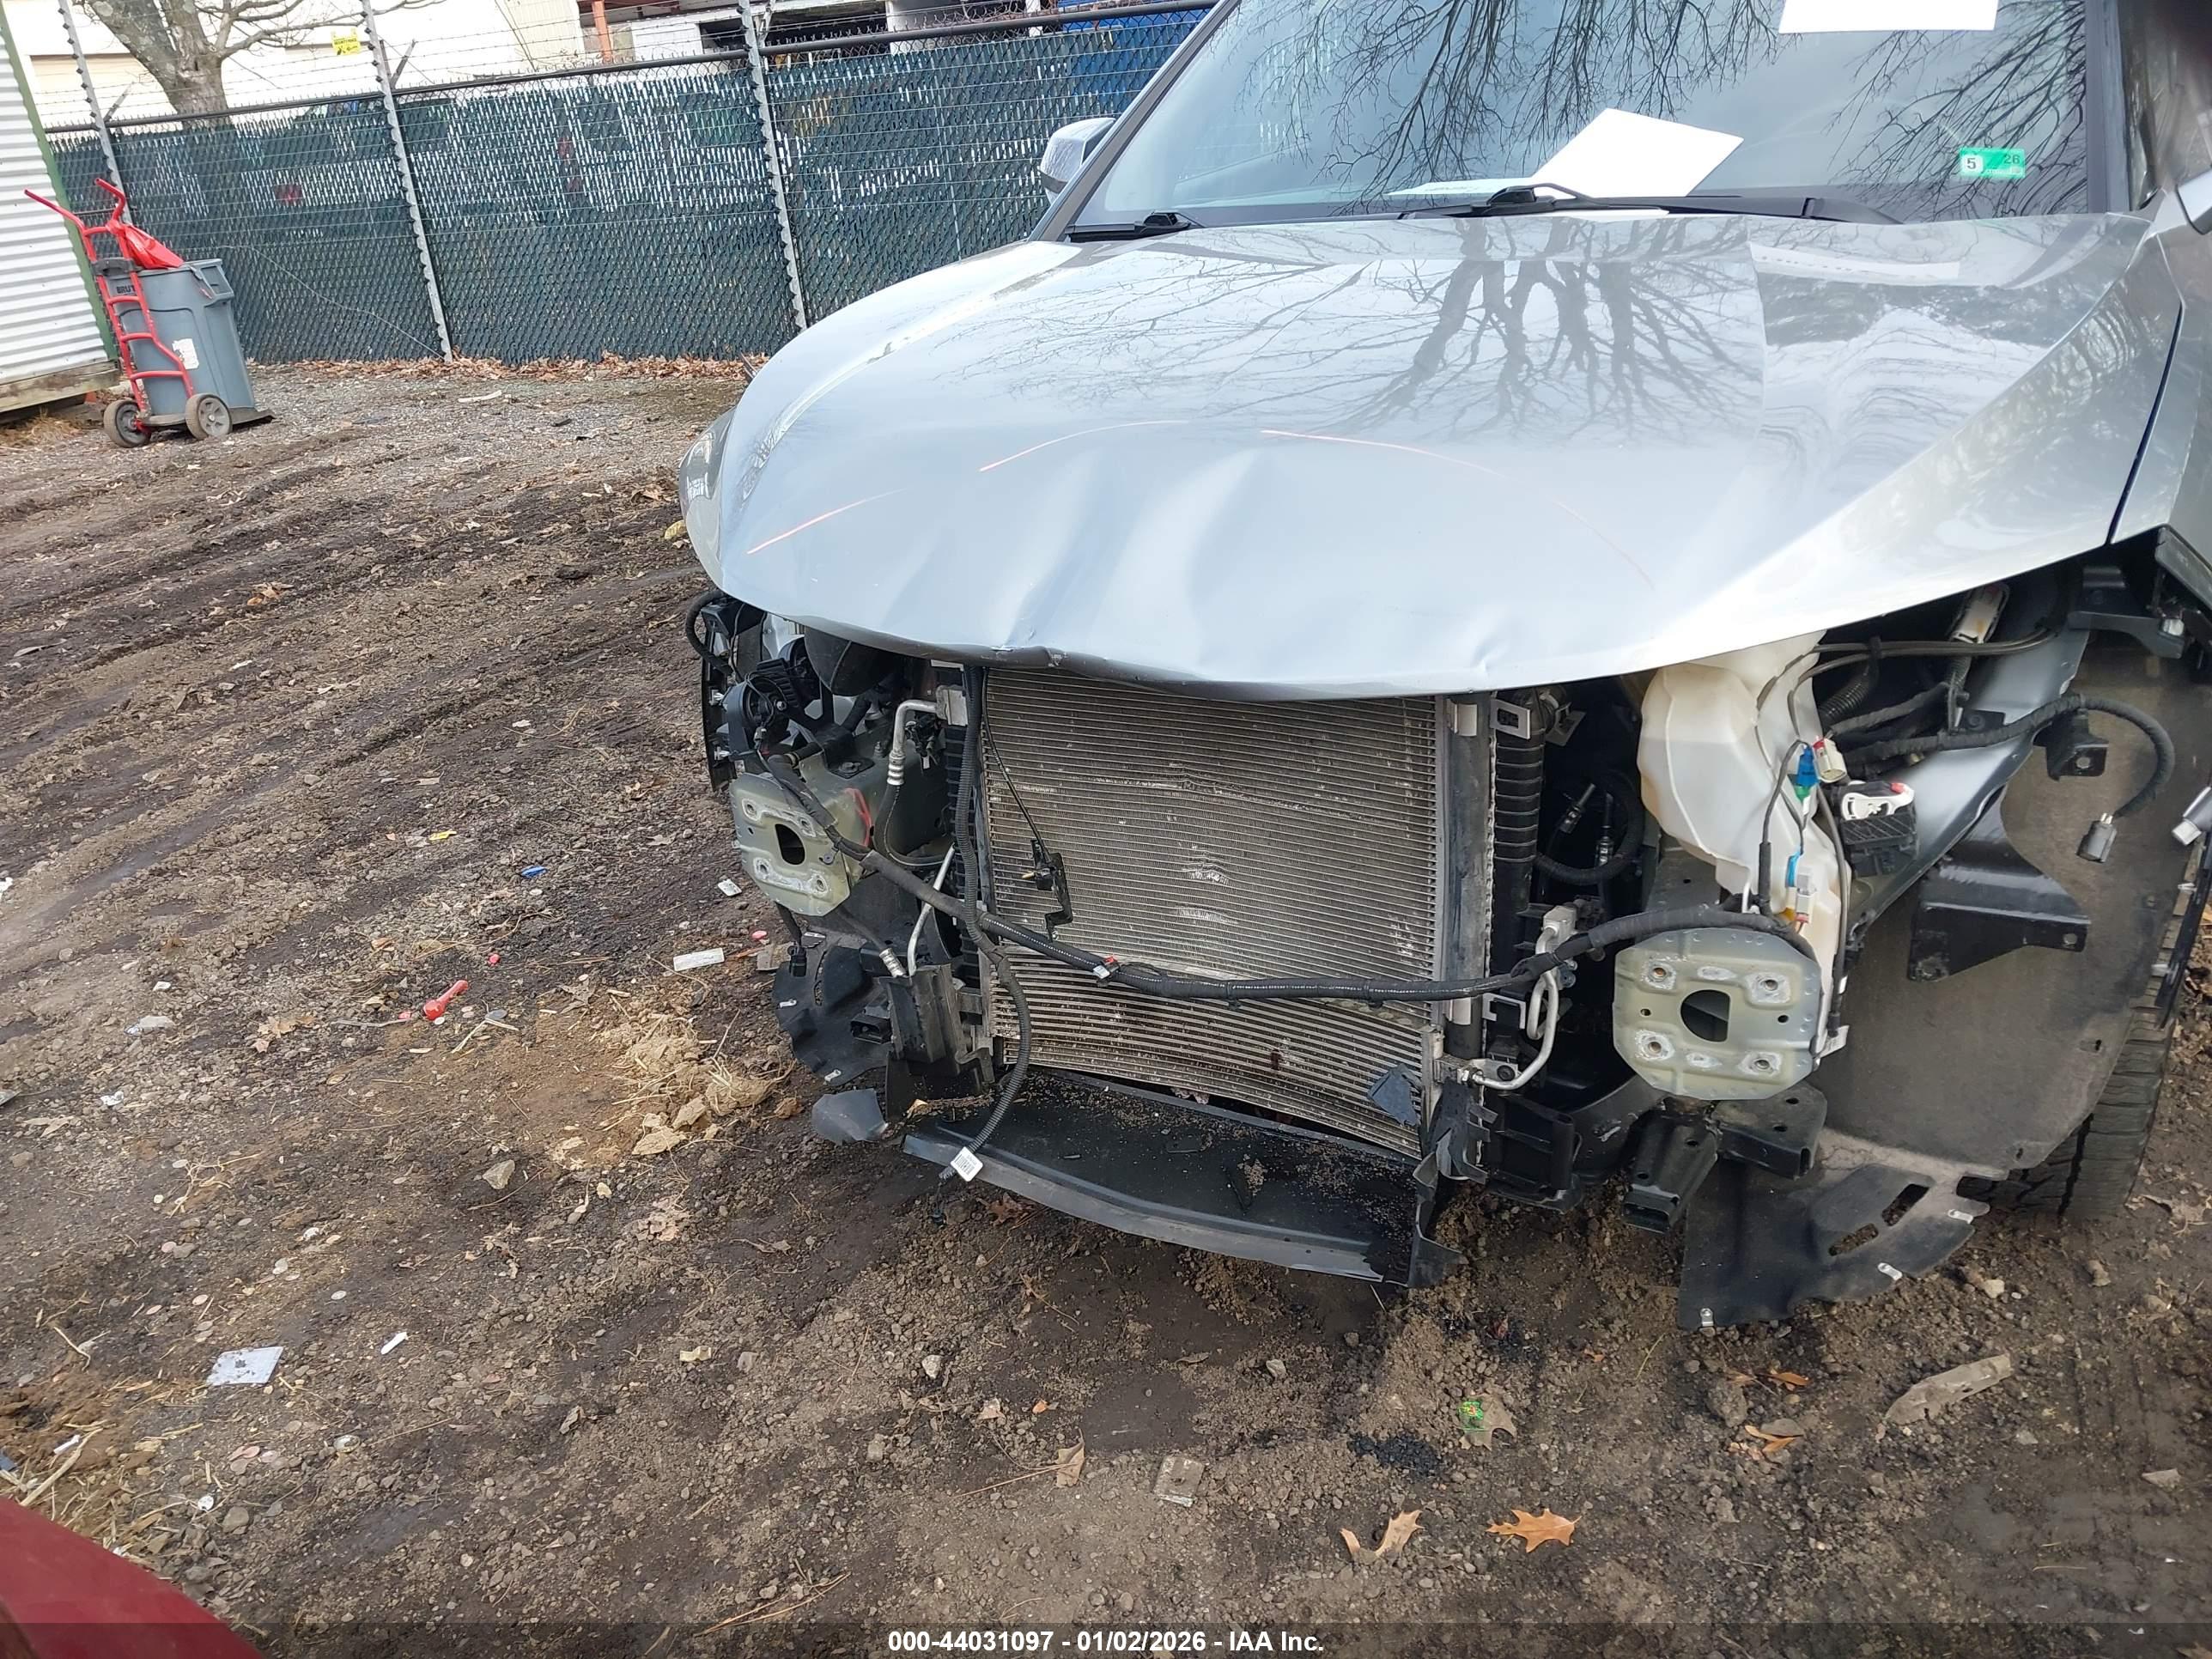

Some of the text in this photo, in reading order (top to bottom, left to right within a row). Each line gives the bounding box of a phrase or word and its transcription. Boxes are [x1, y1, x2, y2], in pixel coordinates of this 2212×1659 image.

[1966, 157, 1977, 169] 5
[2003, 155, 2021, 164] 26
[116, 284, 137, 294] BRUT
